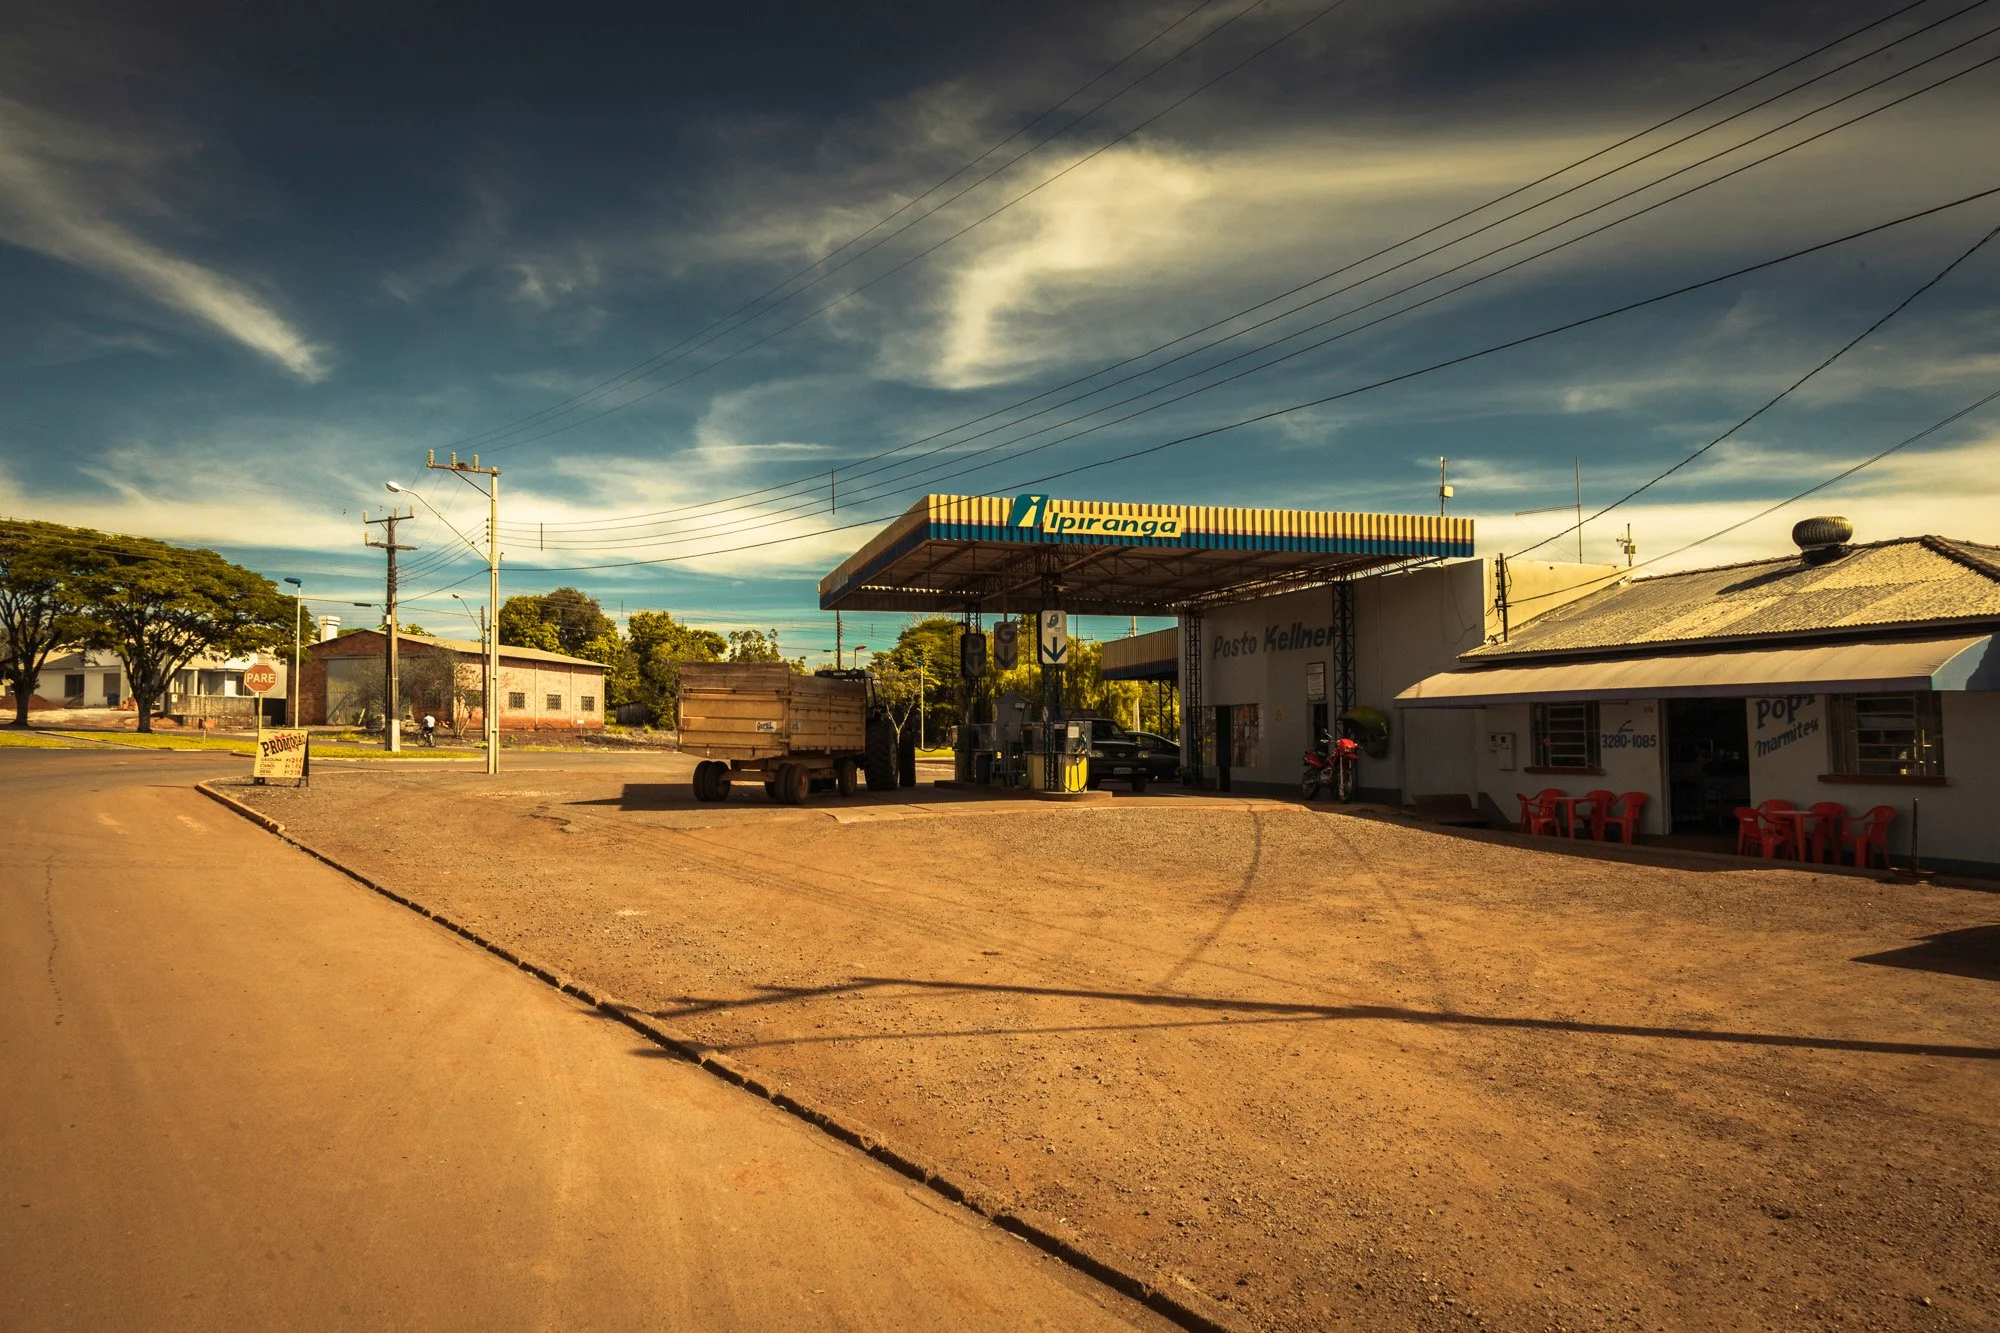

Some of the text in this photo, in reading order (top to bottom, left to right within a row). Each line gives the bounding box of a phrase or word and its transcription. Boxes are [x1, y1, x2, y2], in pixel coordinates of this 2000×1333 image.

[1050, 512, 1176, 536] Ipiranga
[997, 623, 1016, 644] G
[1212, 622, 1338, 659] Posto Kellner
[246, 673, 276, 684] PARE
[1602, 734, 1657, 749] 3280-1085
